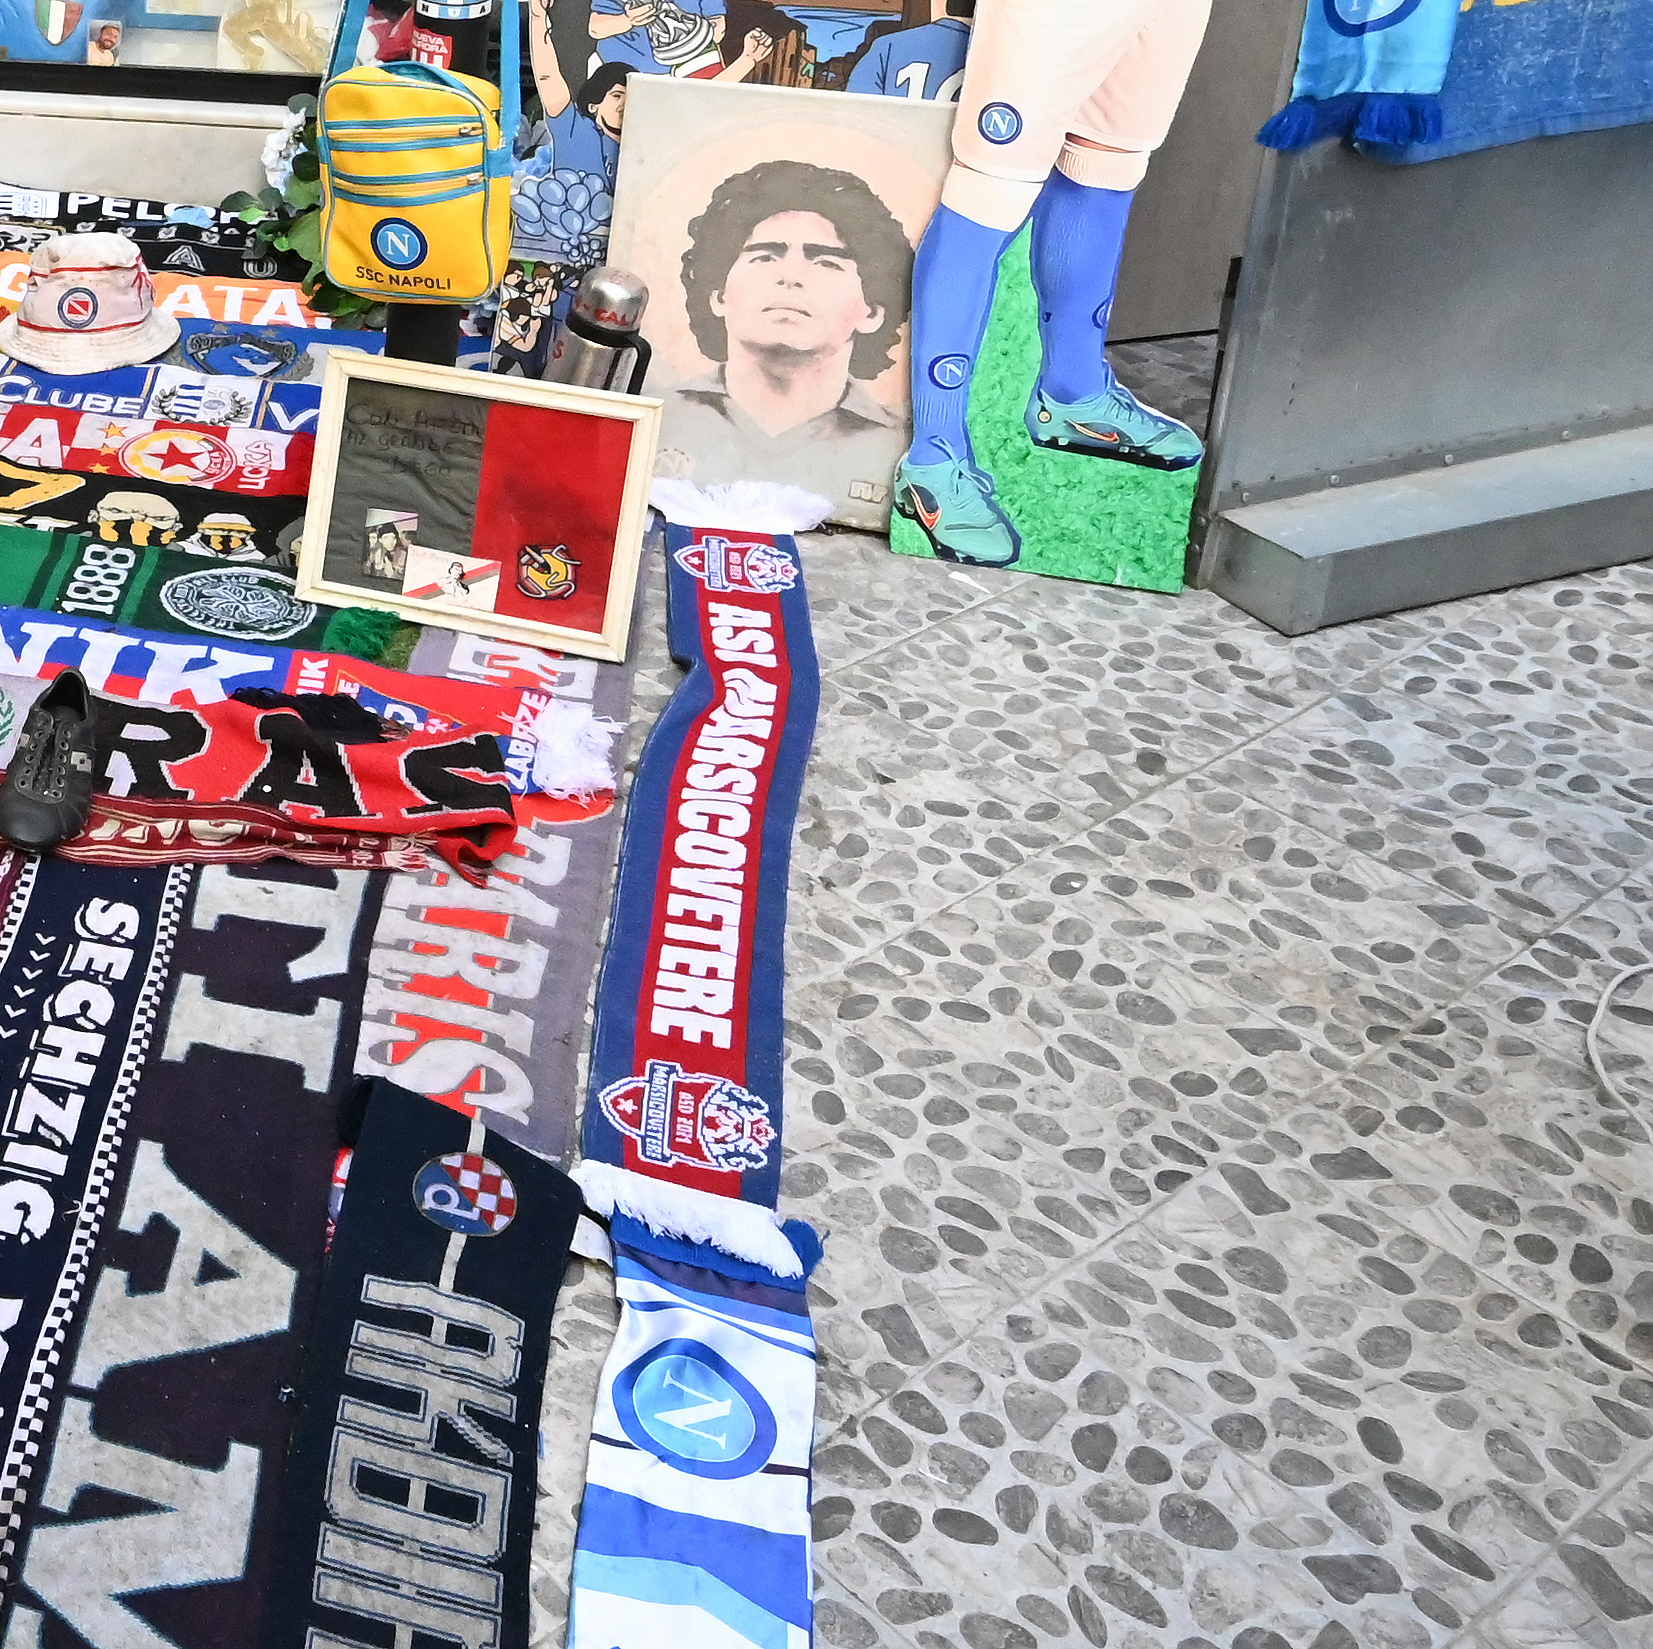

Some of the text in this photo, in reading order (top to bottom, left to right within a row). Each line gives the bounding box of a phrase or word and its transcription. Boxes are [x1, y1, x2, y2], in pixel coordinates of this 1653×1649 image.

[355, 263, 452, 291] SSC NAPOLI
[61, 544, 138, 620] 1888
